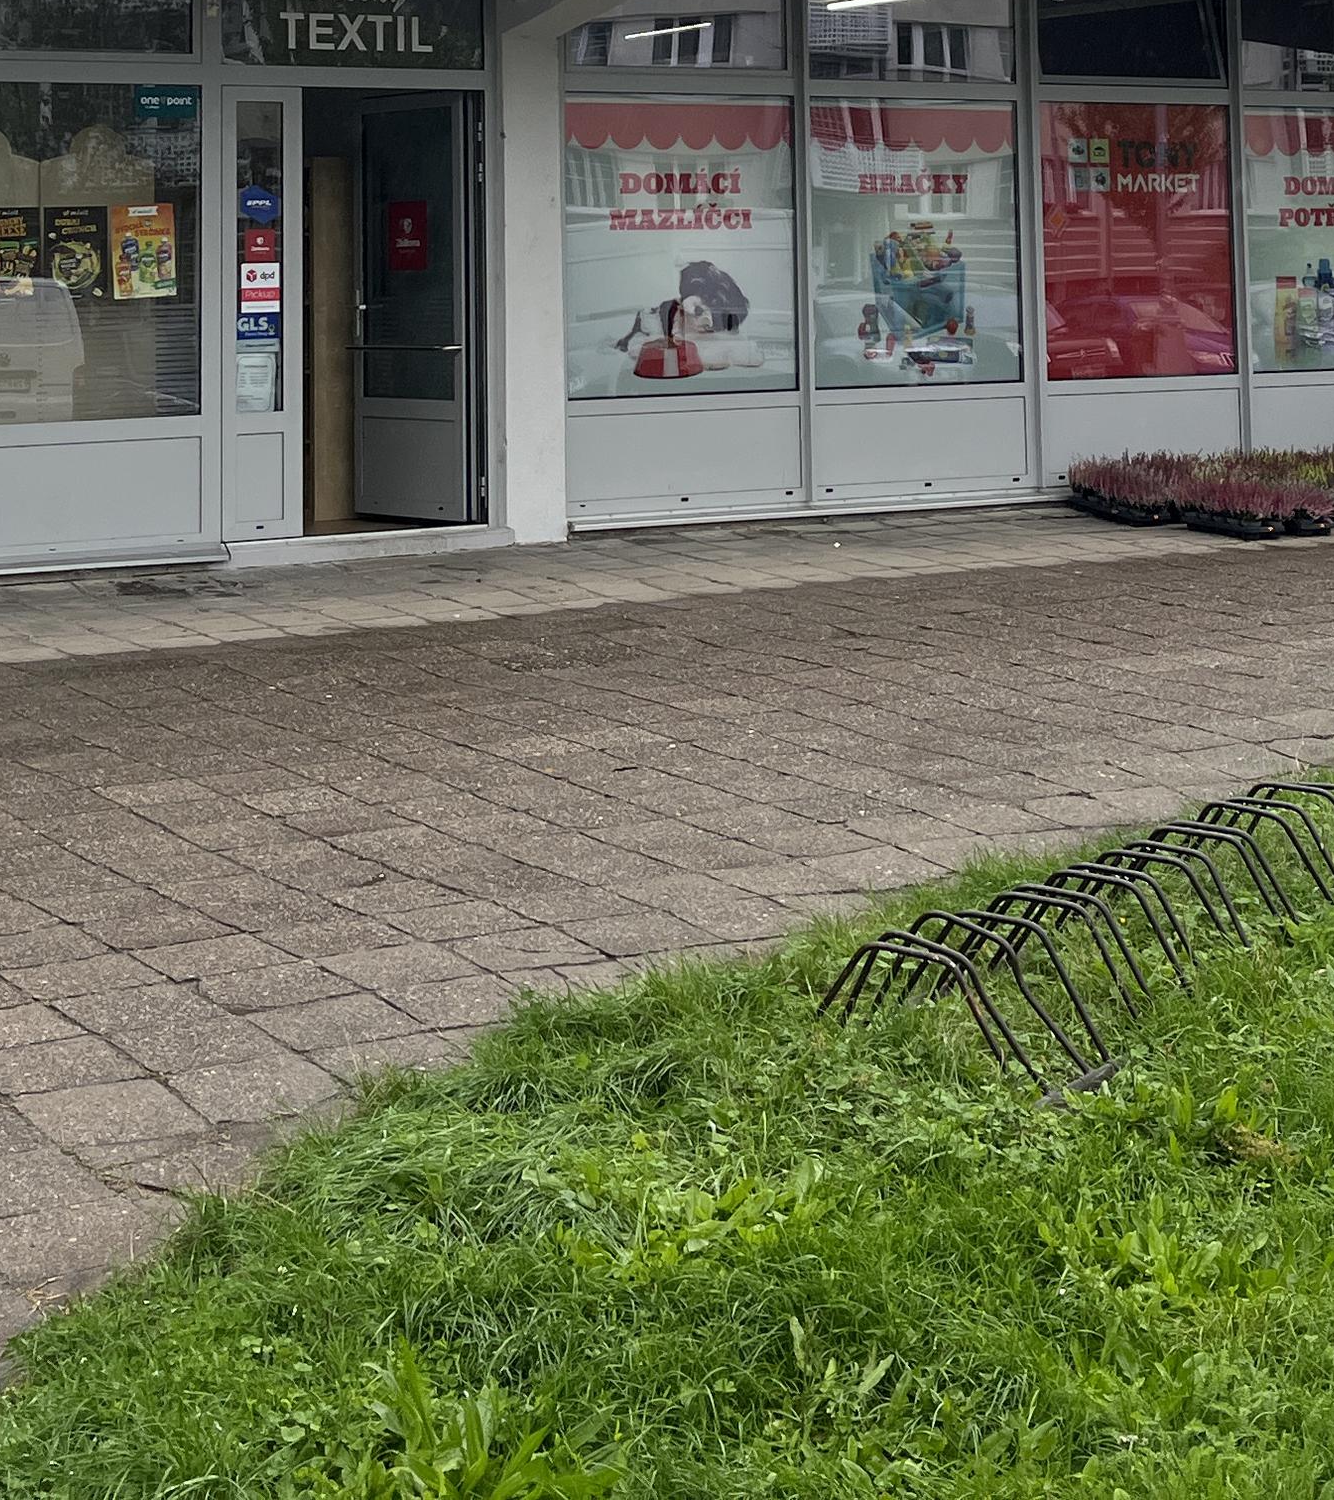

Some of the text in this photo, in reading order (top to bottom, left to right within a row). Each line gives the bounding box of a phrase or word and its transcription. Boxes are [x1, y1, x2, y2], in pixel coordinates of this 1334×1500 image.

[279, 12, 433, 52] TEXTIL
[1117, 140, 1197, 168] TONY
[619, 168, 742, 195] DOMÁCÍ
[857, 168, 969, 195] HRAČKY
[1117, 173, 1201, 193] MARKET
[609, 203, 753, 231] MAZLÍČCI
[260, 271, 276, 282] dpd
[237, 316, 269, 332] GLS
